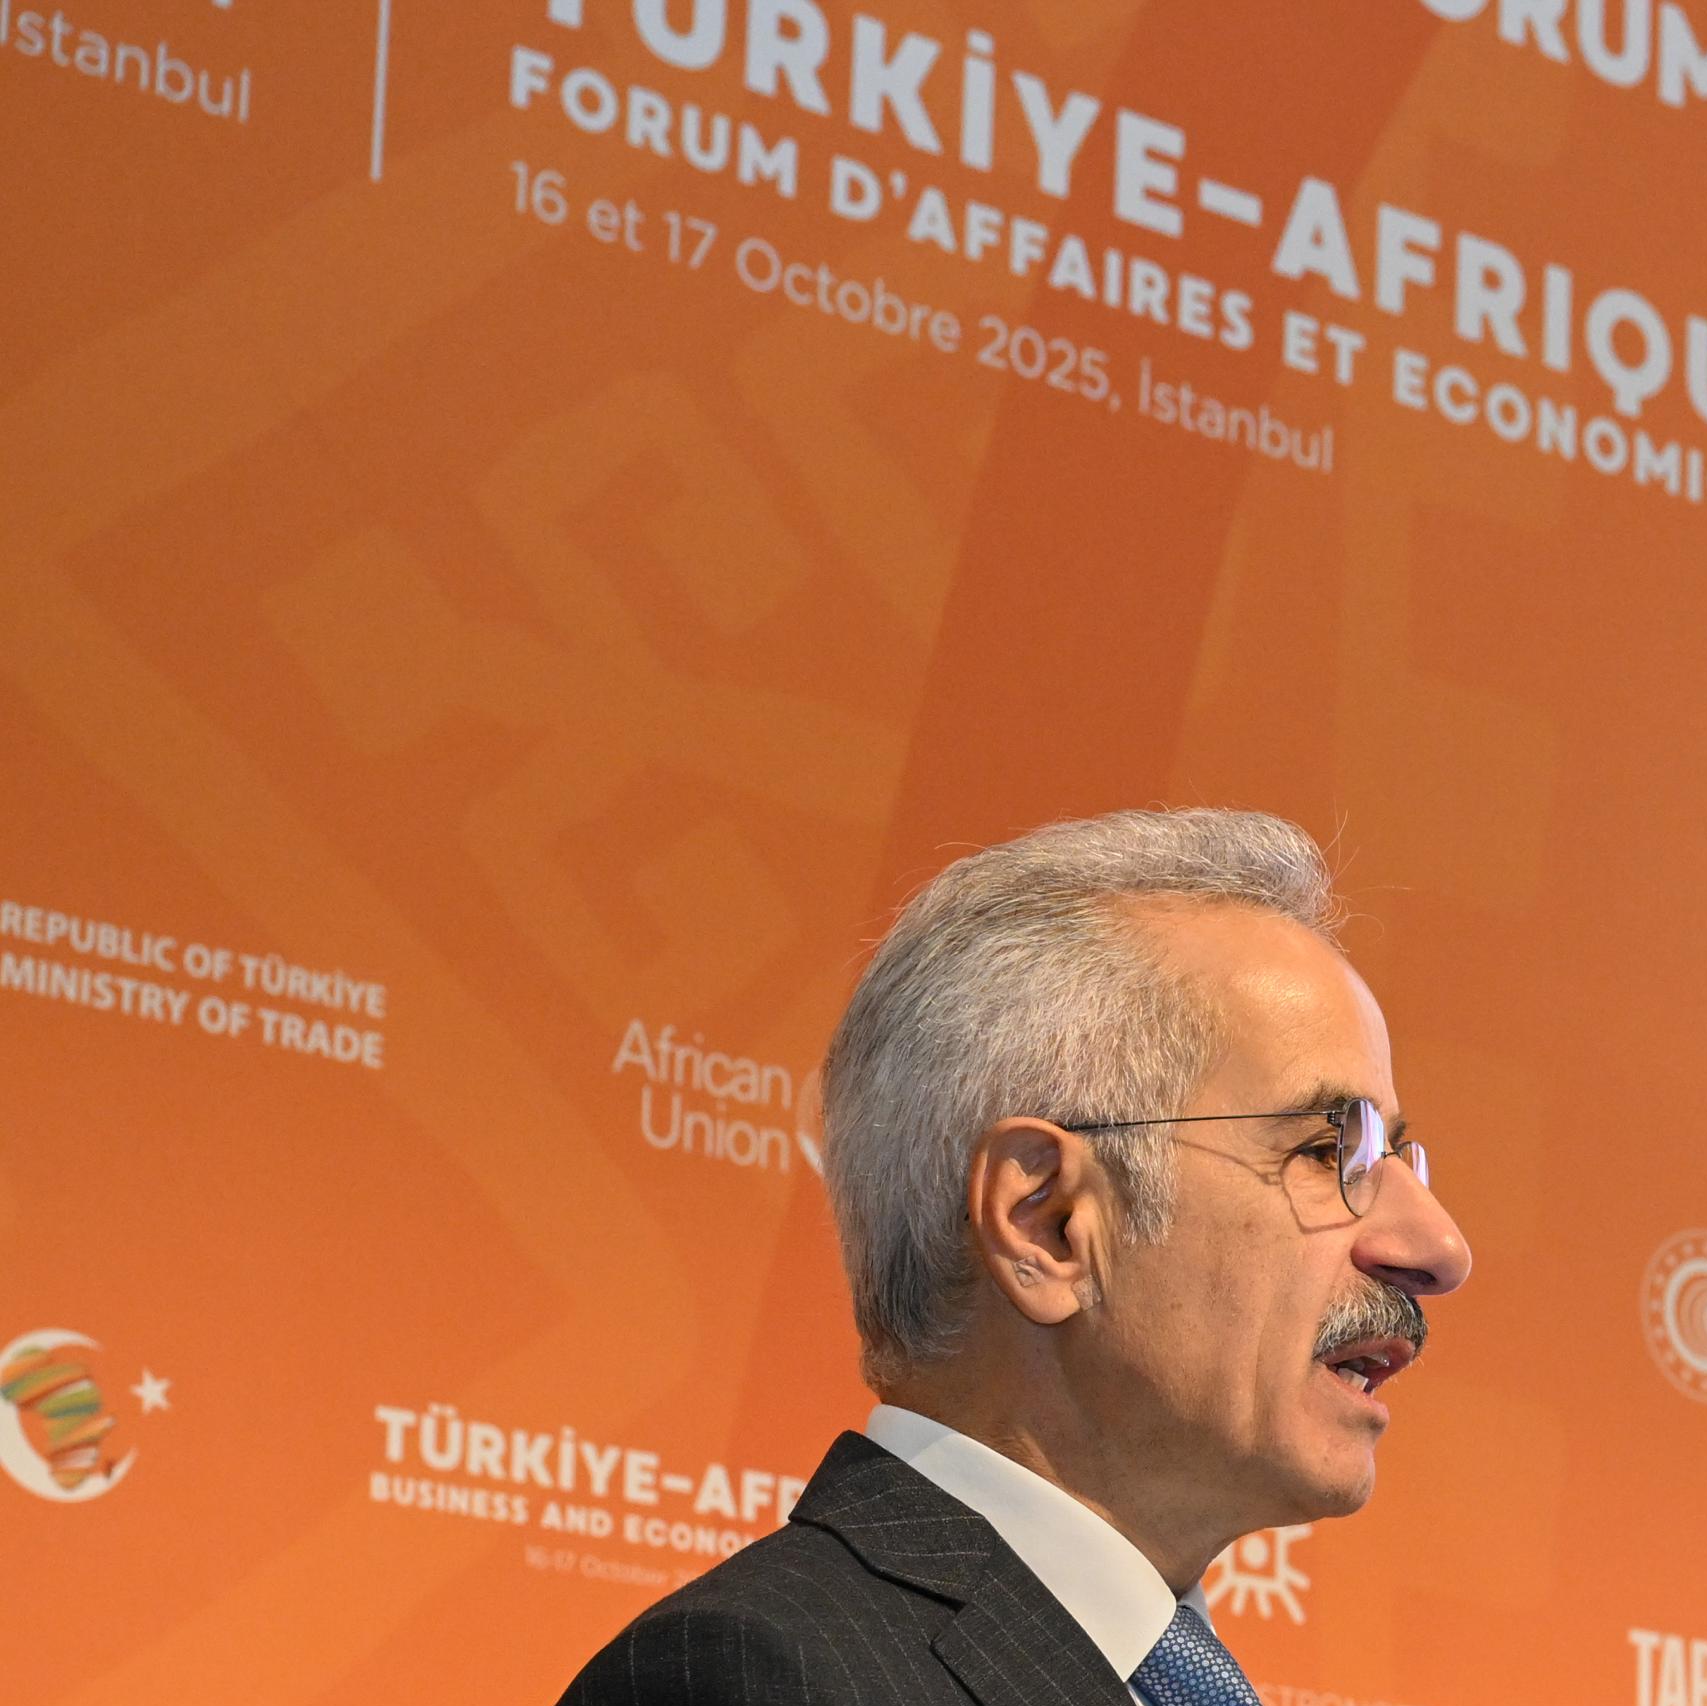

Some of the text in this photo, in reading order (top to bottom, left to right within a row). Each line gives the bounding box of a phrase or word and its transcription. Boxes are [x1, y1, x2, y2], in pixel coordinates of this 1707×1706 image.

[509, 45, 797, 199] FORUM
[828, 155, 1254, 350] D'AFFAIRES
[1283, 310, 1366, 387] ET
[509, 160, 1334, 473] 16 et 17 Octobre 2025, İstanbul
[0, 900, 387, 1019] REPUBLIC OF TÜRKİYE
[0, 951, 385, 1069] MINISTRY OF TRADE
[612, 1018, 792, 1111] African
[641, 1085, 790, 1174] Union
[369, 1471, 757, 1557] BUSINESS AND ECONO
